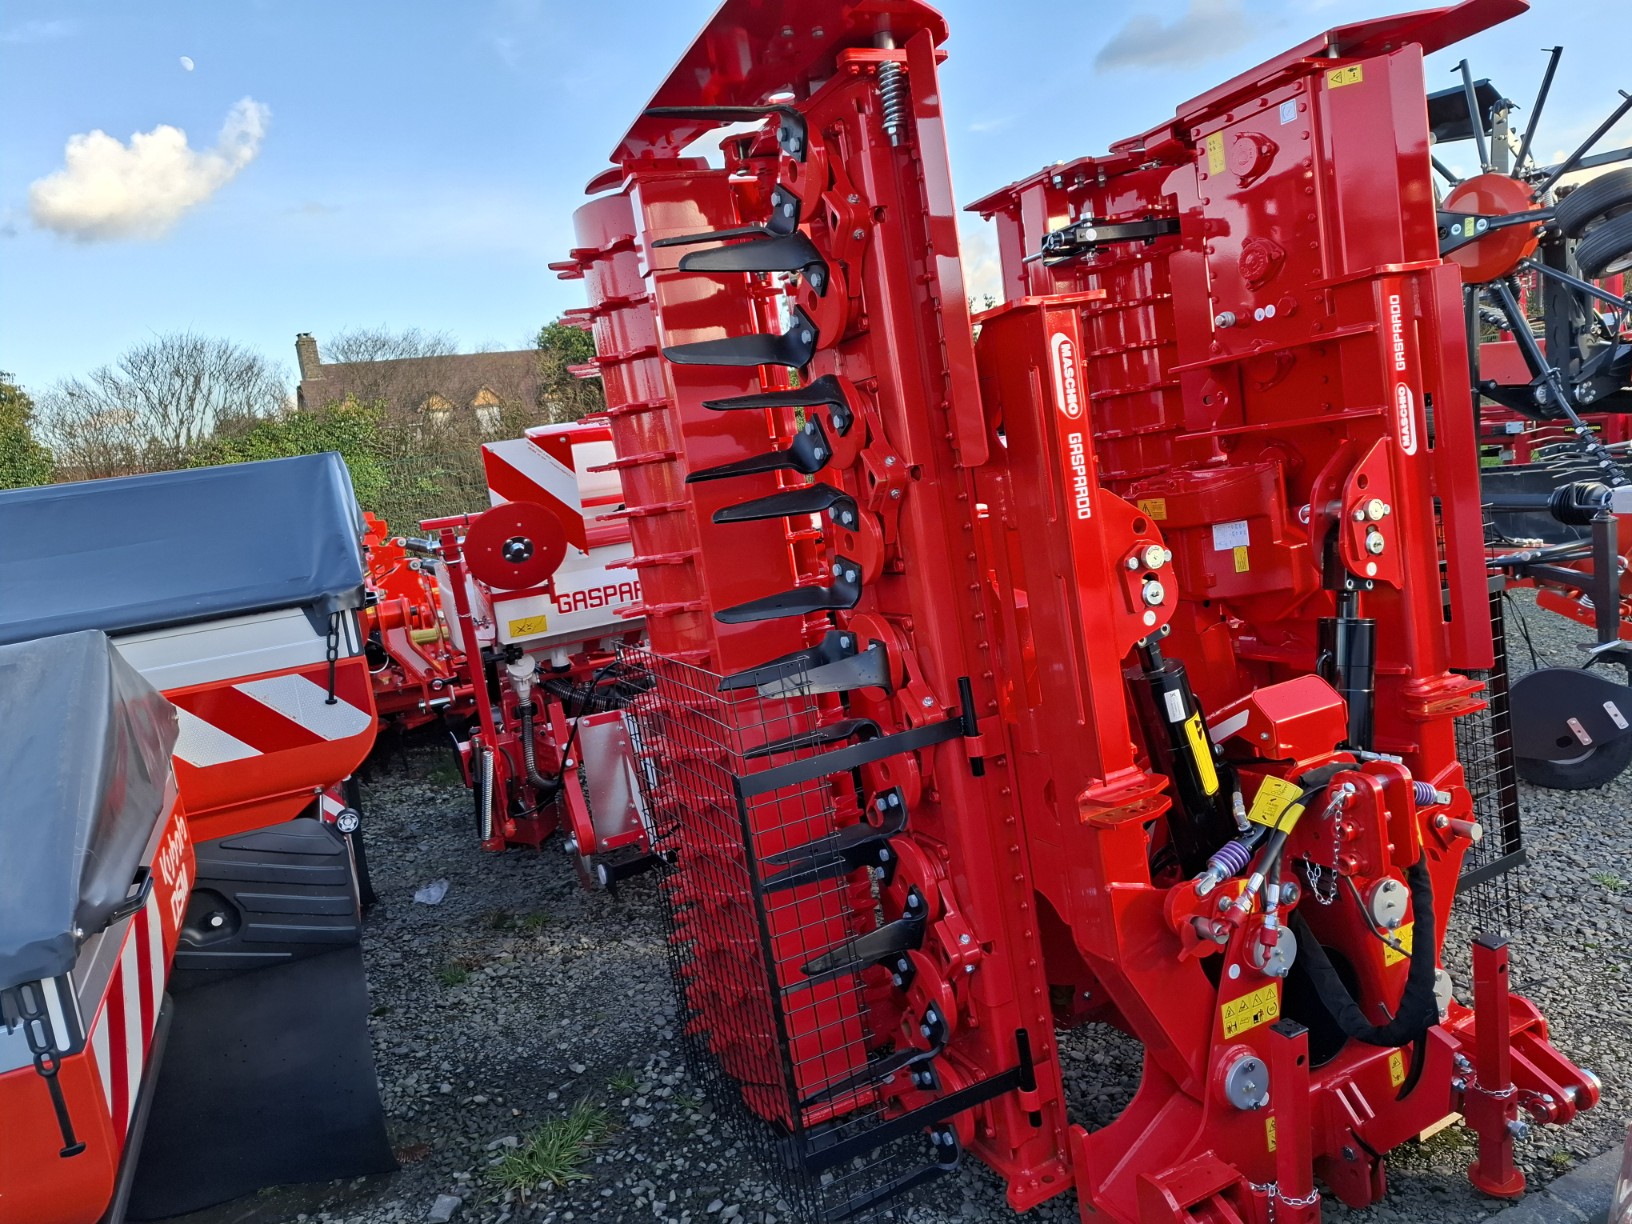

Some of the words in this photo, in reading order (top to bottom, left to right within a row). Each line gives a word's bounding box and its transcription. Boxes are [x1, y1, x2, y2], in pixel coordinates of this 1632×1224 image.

[1389, 295, 1406, 371] GASPARDO
[1060, 343, 1079, 415] MASCHIO
[1398, 386, 1411, 447] MASCHIO
[1068, 432, 1091, 520] GASPARDO
[159, 813, 188, 886] Kubota
